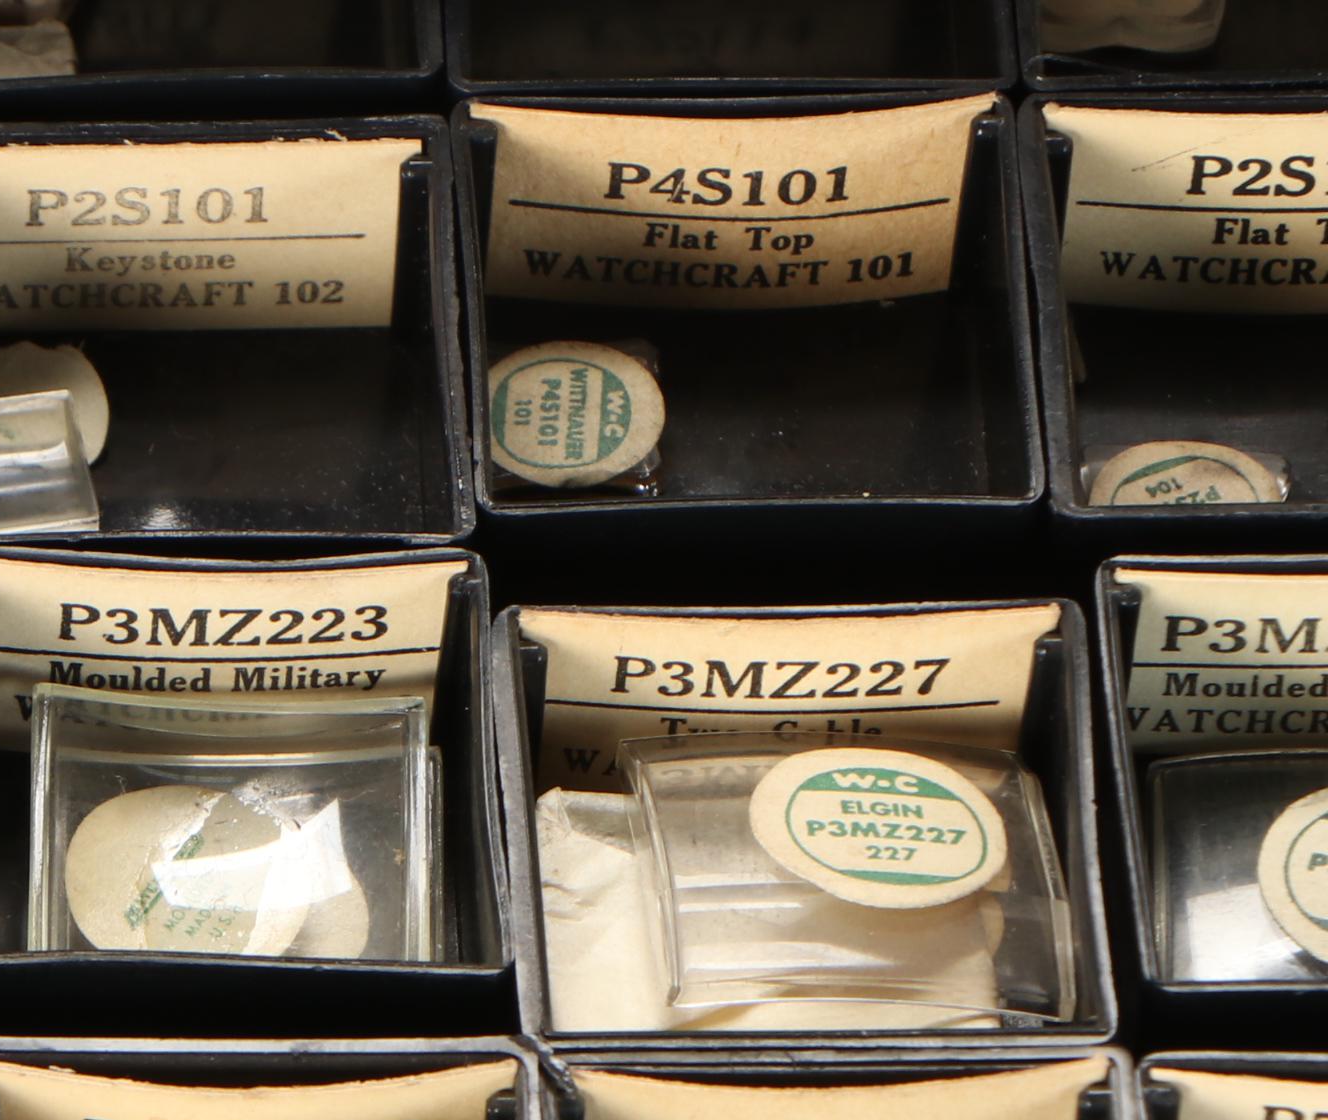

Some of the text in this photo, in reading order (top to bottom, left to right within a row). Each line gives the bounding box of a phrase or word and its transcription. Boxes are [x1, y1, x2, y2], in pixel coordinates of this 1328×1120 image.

[603, 162, 851, 207] P4S101
[1186, 155, 1328, 197] P2S
[24, 186, 270, 228] P2S101
[643, 223, 815, 255] Flat Top
[1211, 218, 1290, 246] Flat
[64, 247, 236, 278] Keystone
[522, 249, 916, 288] WATCHCRAFT 101
[275, 280, 345, 305] 102
[57, 603, 390, 647] P3MZ223
[1160, 615, 1328, 654] P3M
[48, 661, 387, 693] Moulded Military
[610, 656, 951, 700] P3MZ227
[832, 771, 921, 793] W-C
[840, 799, 924, 820] ELGIN
[806, 819, 967, 846] P3MZ227
[864, 844, 919, 862] 227
